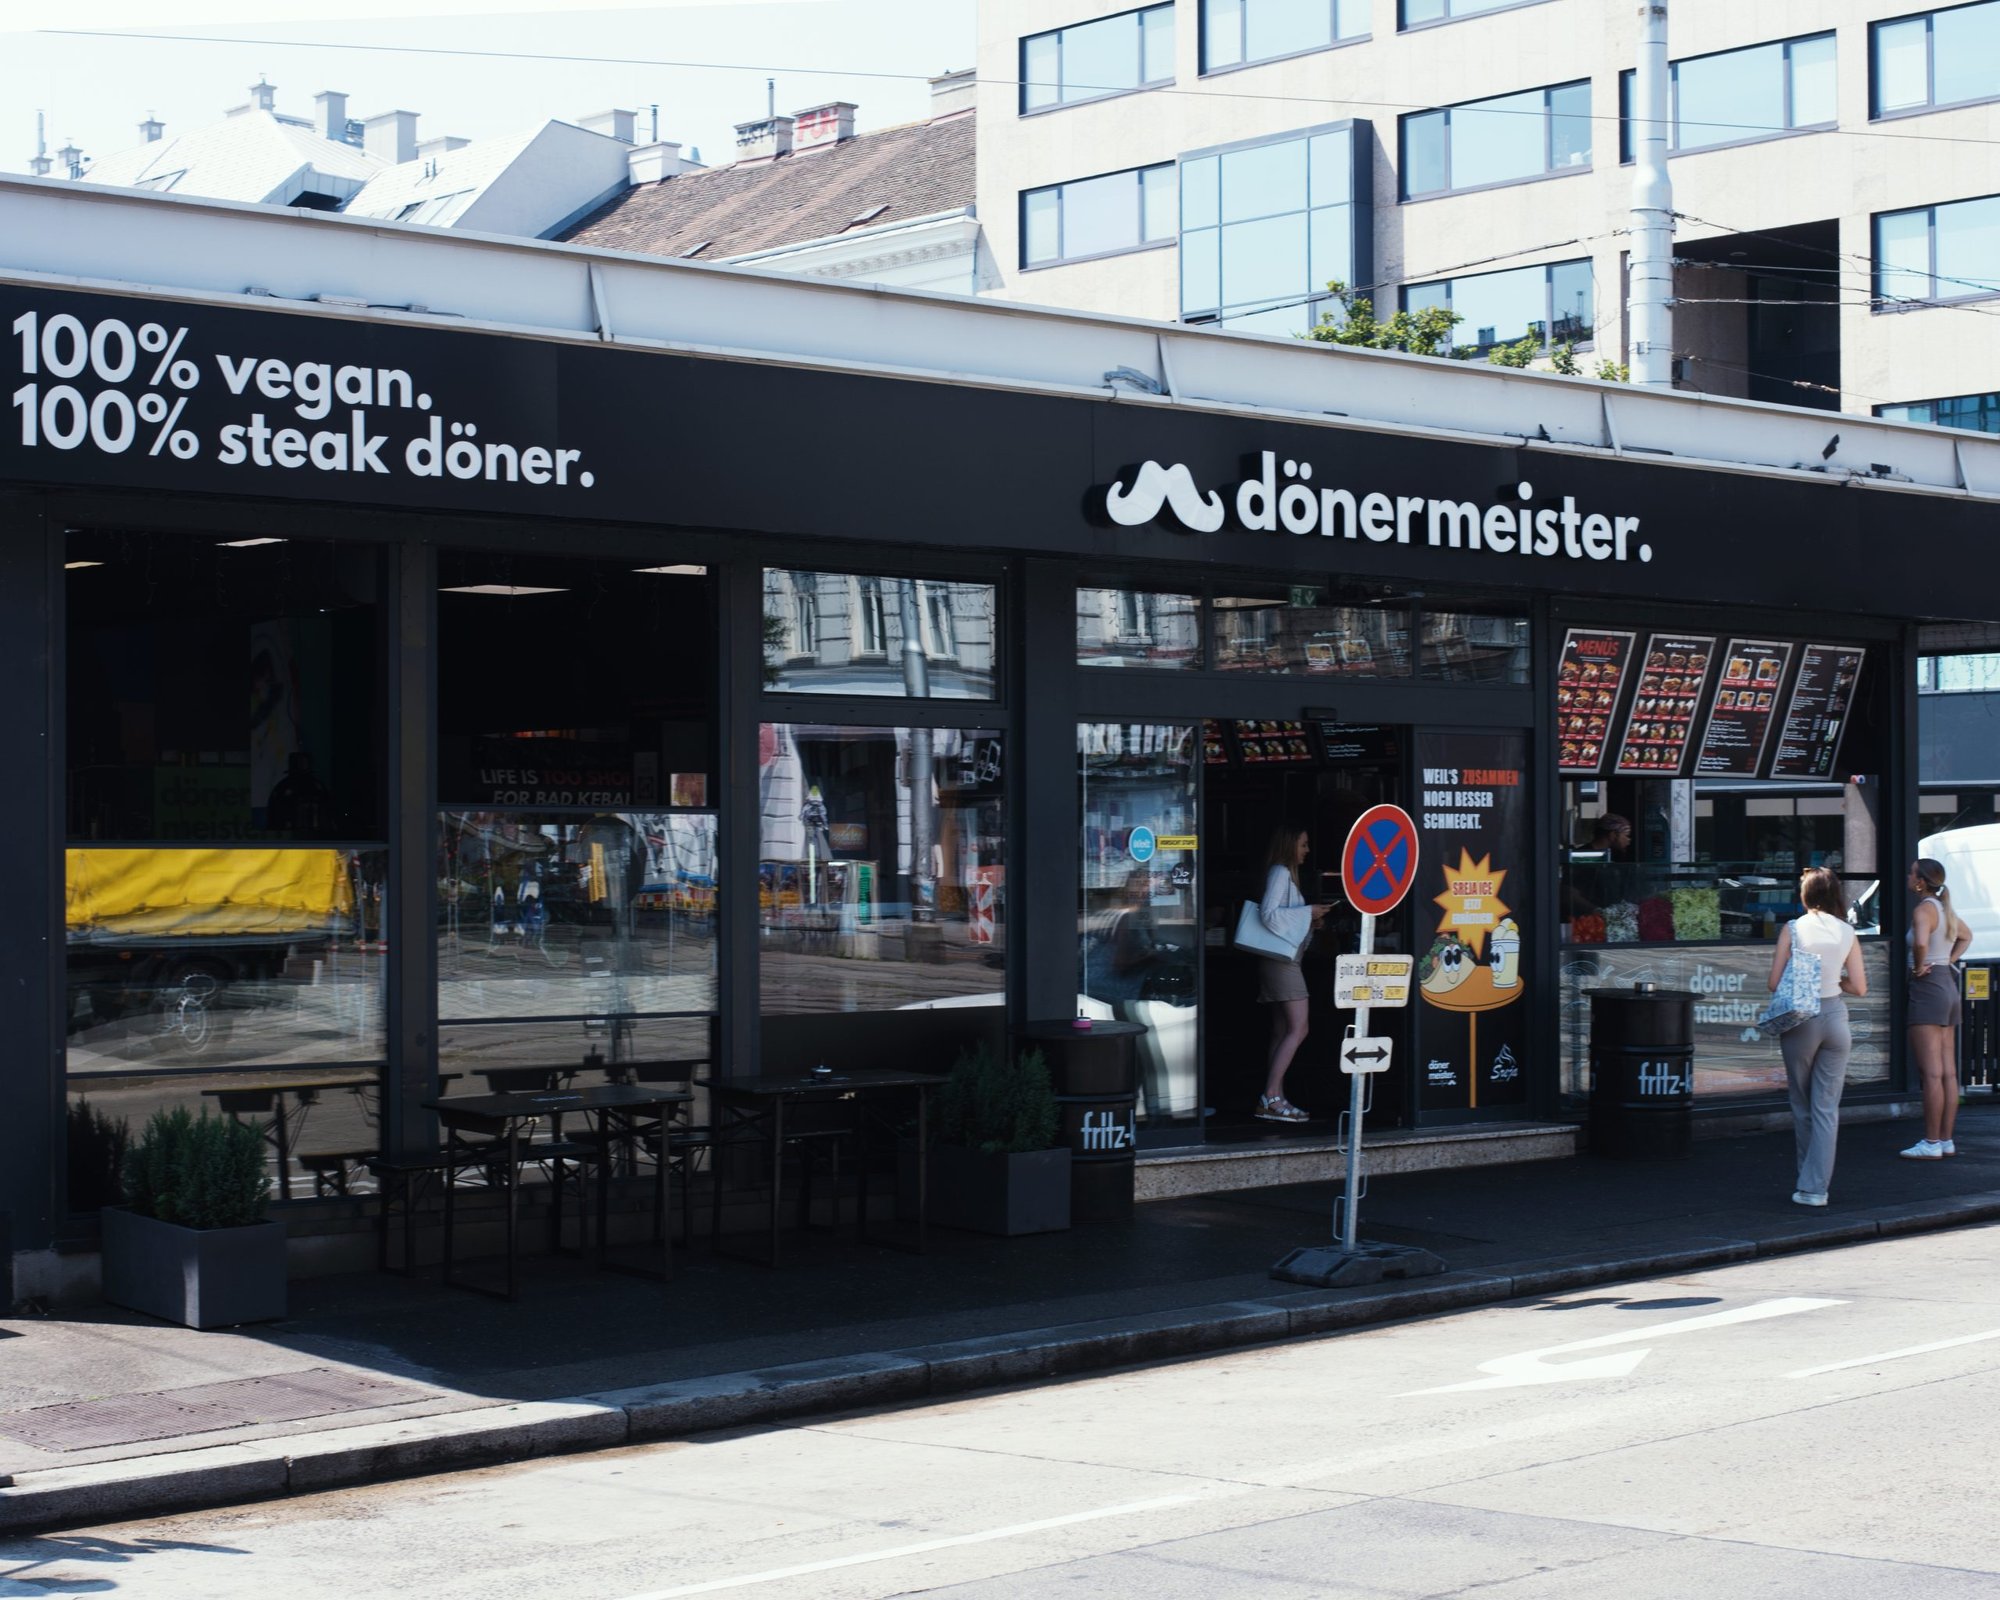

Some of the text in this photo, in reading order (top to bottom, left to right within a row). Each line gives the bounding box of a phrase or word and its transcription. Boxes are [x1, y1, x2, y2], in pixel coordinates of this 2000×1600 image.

[12, 310, 433, 421] 100% vegan.
[12, 383, 595, 488] 100% steak döner.
[1237, 450, 1653, 563] dönermeister.
[481, 769, 630, 786] LIFE IS TOO SHO
[1462, 770, 1519, 785] ZUSAMMEN
[493, 790, 630, 806] FOR BAD KEBA
[1423, 790, 1494, 808] NOCH BESSER
[1423, 812, 1482, 829] SCHMECKT.
[1690, 964, 1748, 993] döner
